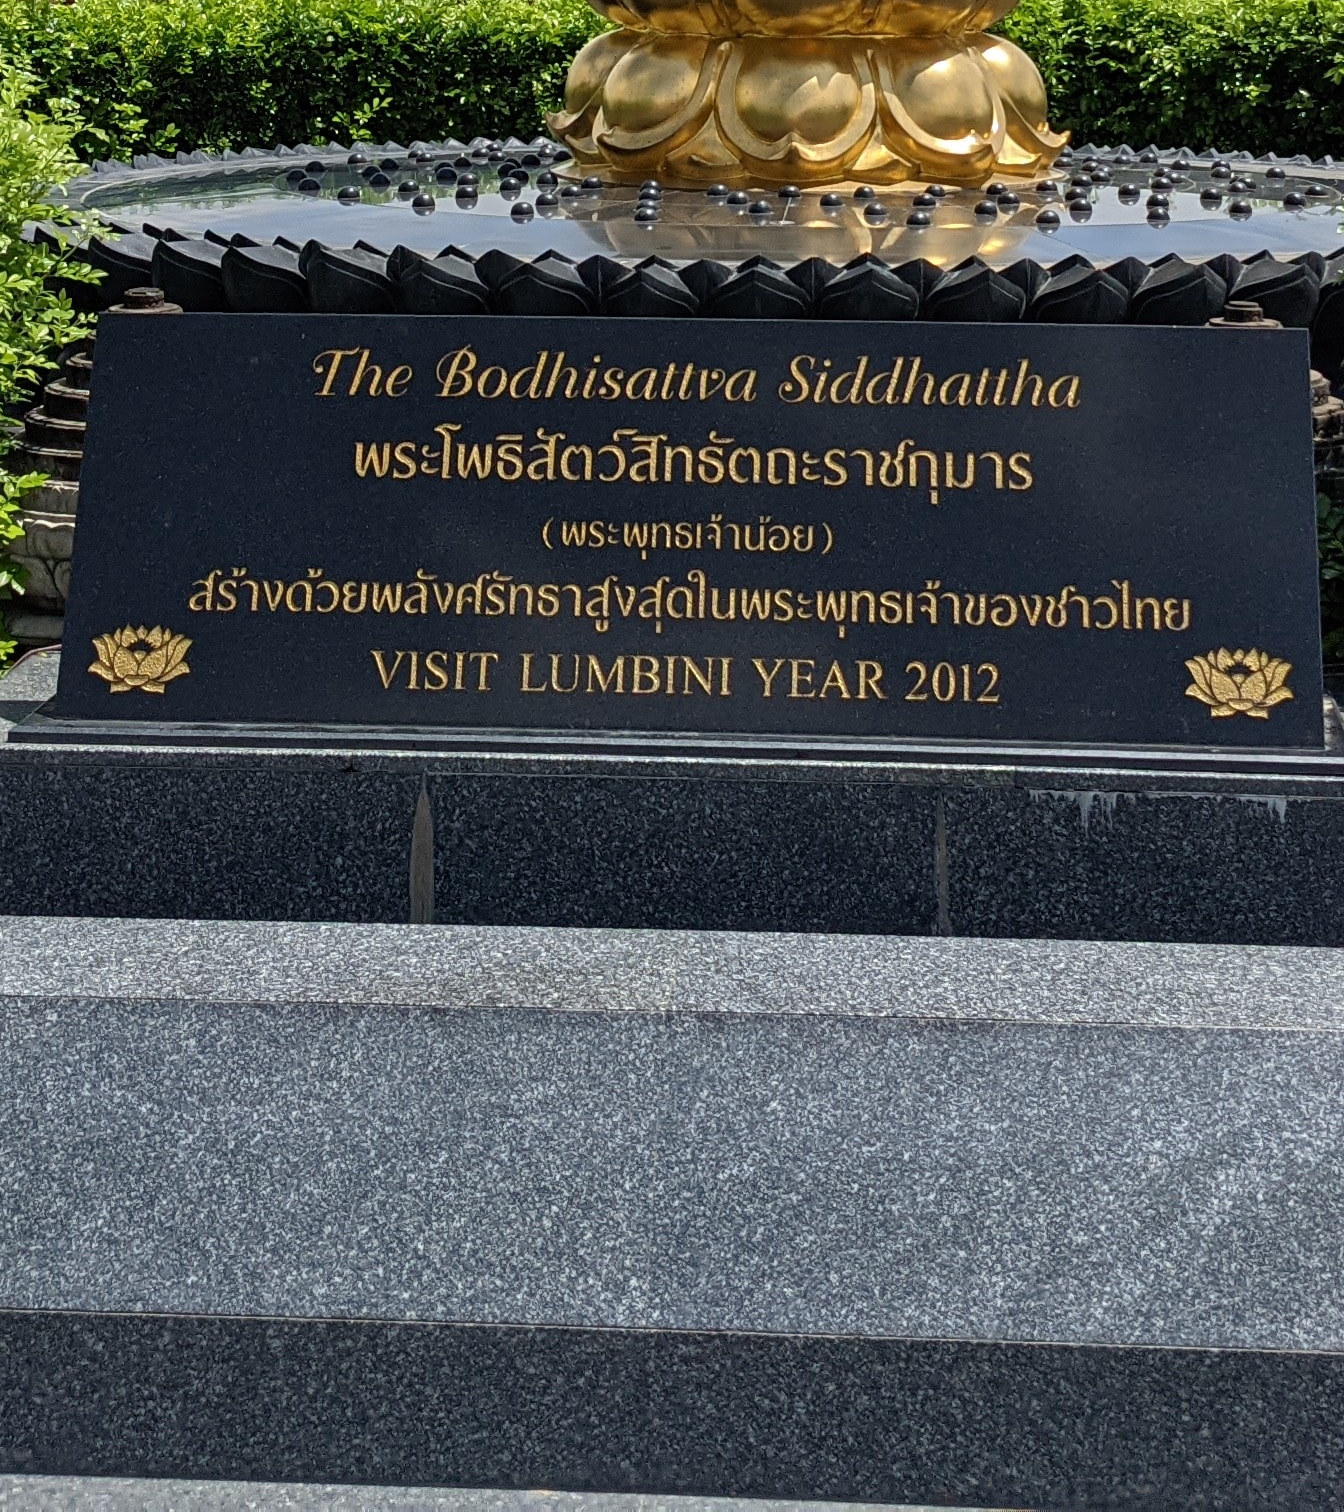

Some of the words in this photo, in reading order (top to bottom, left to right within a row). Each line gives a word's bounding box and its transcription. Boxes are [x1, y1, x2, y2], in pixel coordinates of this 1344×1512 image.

[312, 345, 413, 398] The
[435, 344, 757, 402] Bodhisattva
[778, 354, 1081, 408] Siddhattha
[355, 422, 1034, 505] พระโพธิสัตว์สิทธัตถะราชกุมาร
[541, 513, 834, 560] (พระพุทธเจ้าน้อย)
[188, 567, 1192, 639] สร้างด้วยพลังศรัทธาสูงสุดในพระพุทธเจ้าของชาวไทย
[370, 649, 499, 691] VISIT
[520, 653, 734, 696] LUMBINI
[752, 657, 889, 700] YEAR
[904, 660, 1001, 703] 2012
